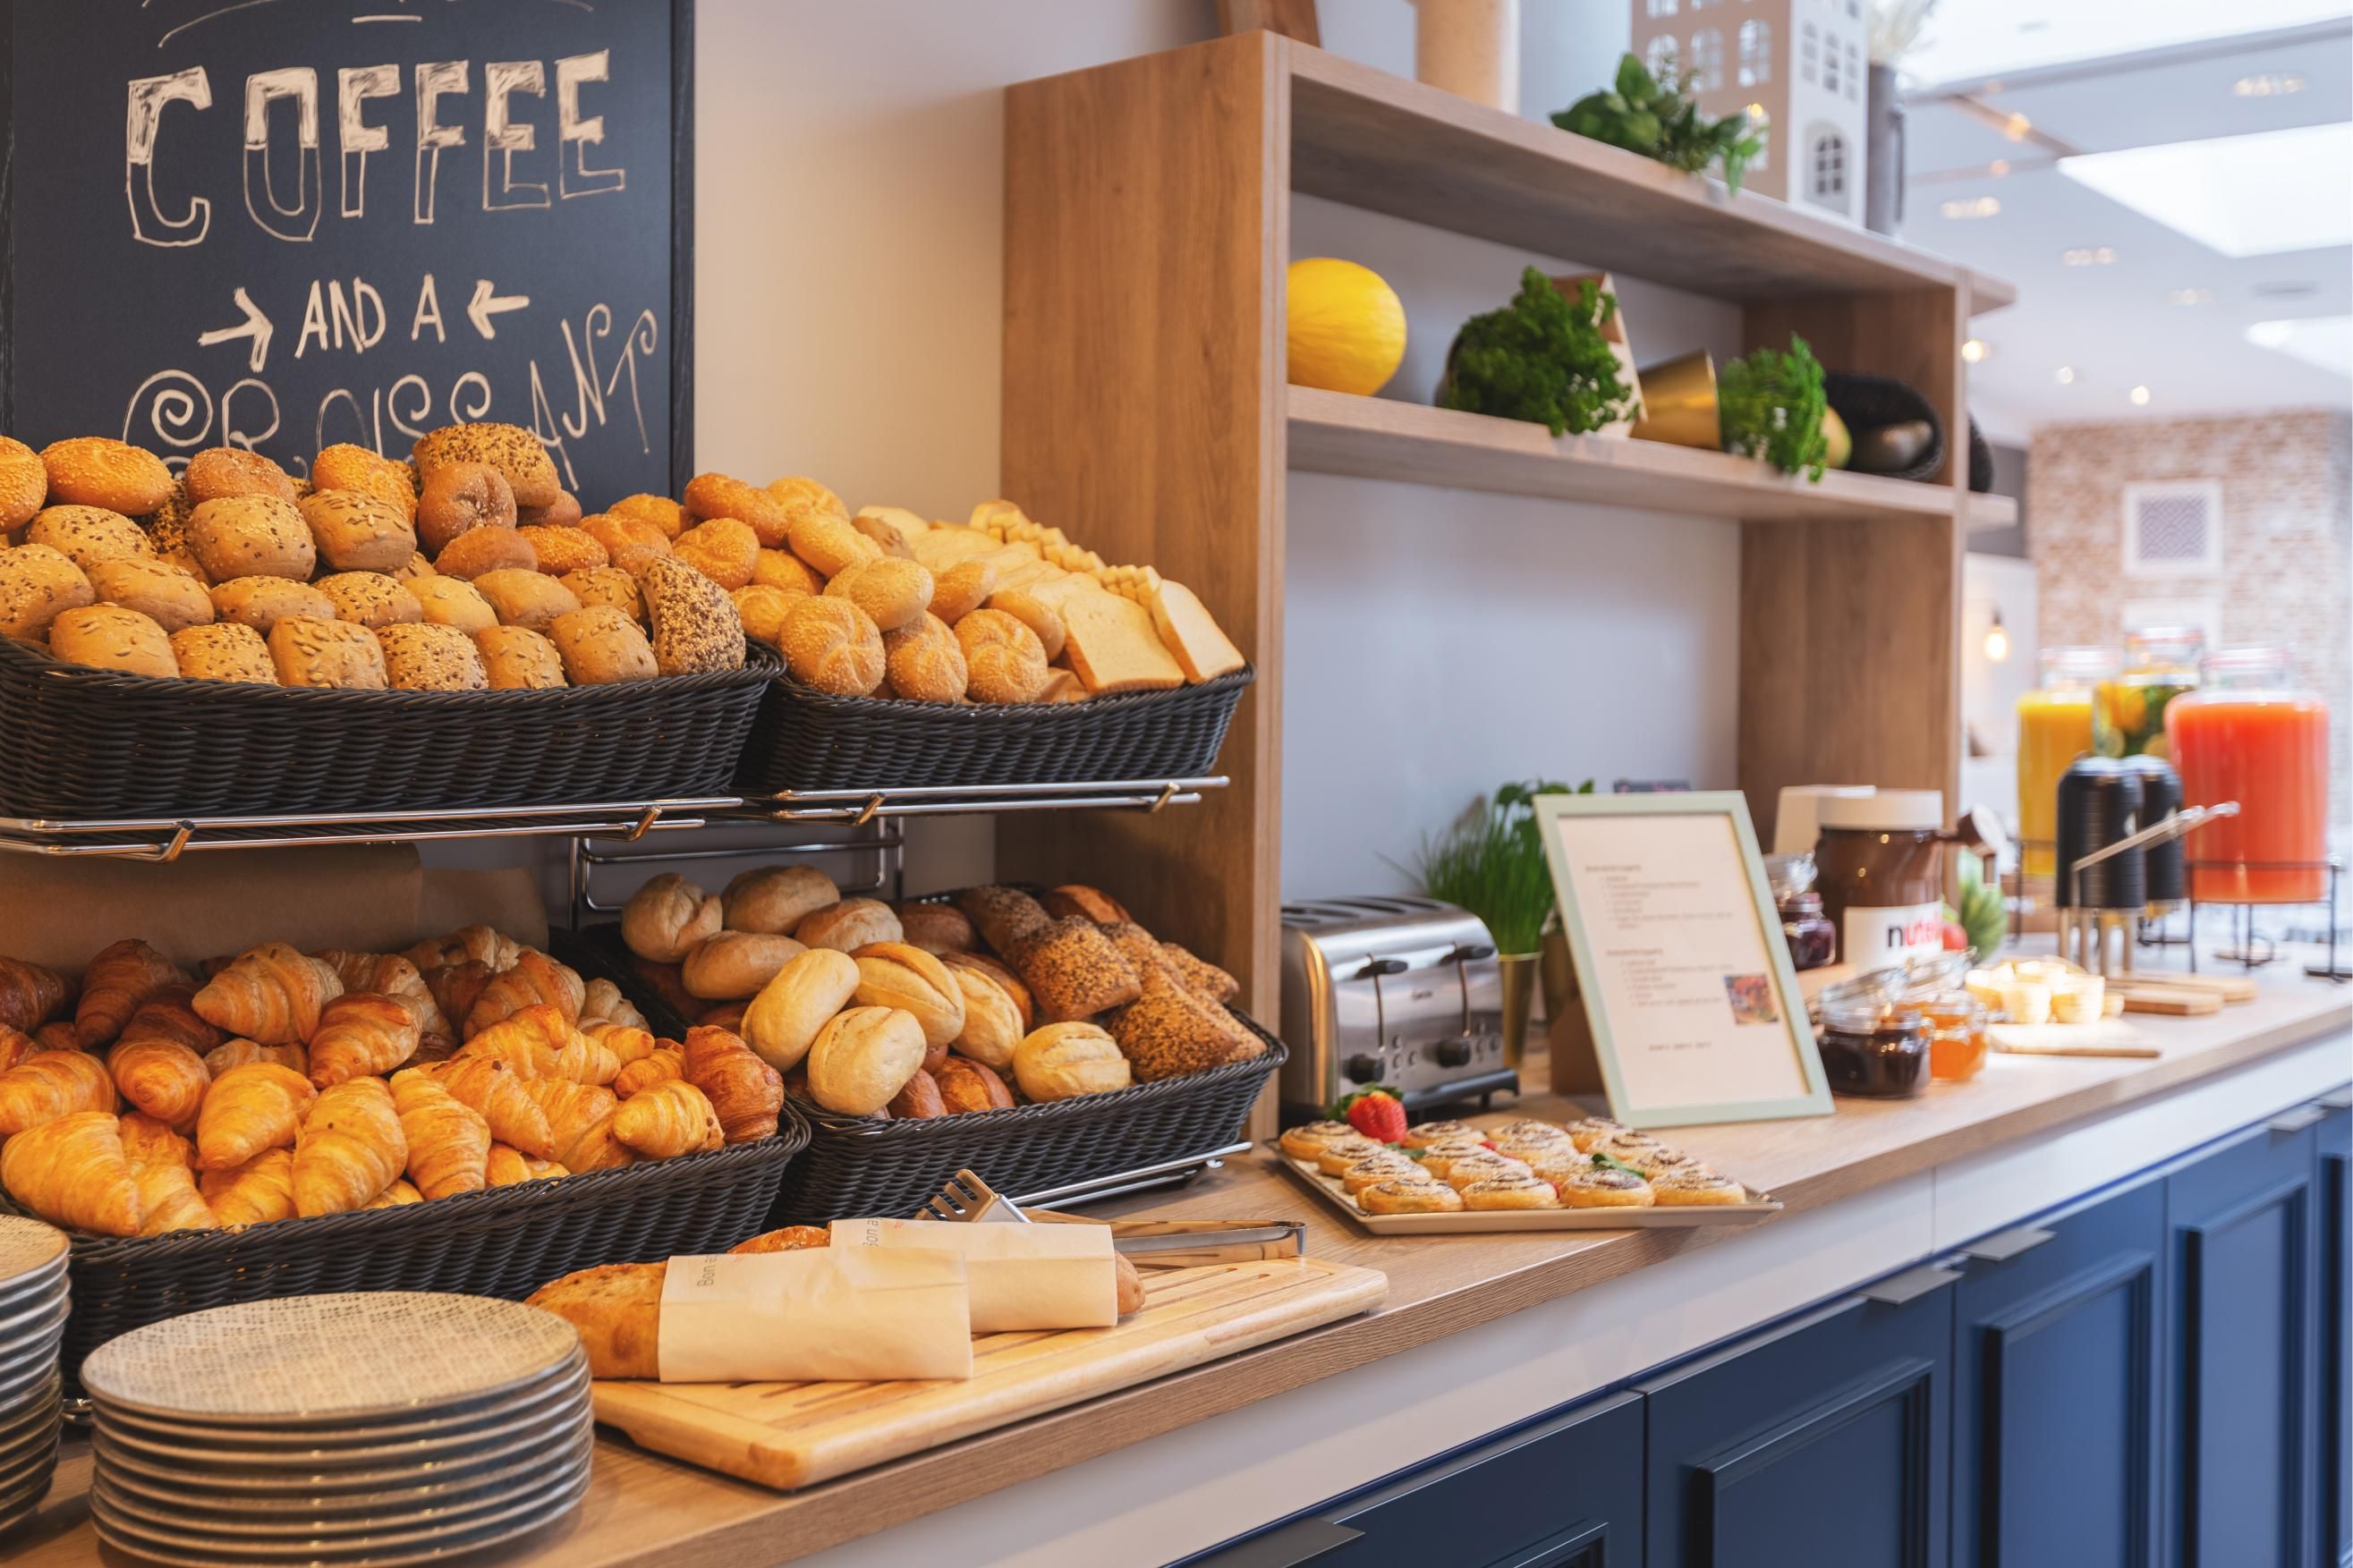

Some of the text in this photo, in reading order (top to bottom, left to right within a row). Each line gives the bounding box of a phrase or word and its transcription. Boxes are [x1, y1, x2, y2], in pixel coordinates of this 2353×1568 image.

[125, 49, 624, 247] COFFEE
[294, 273, 446, 358] AND A
